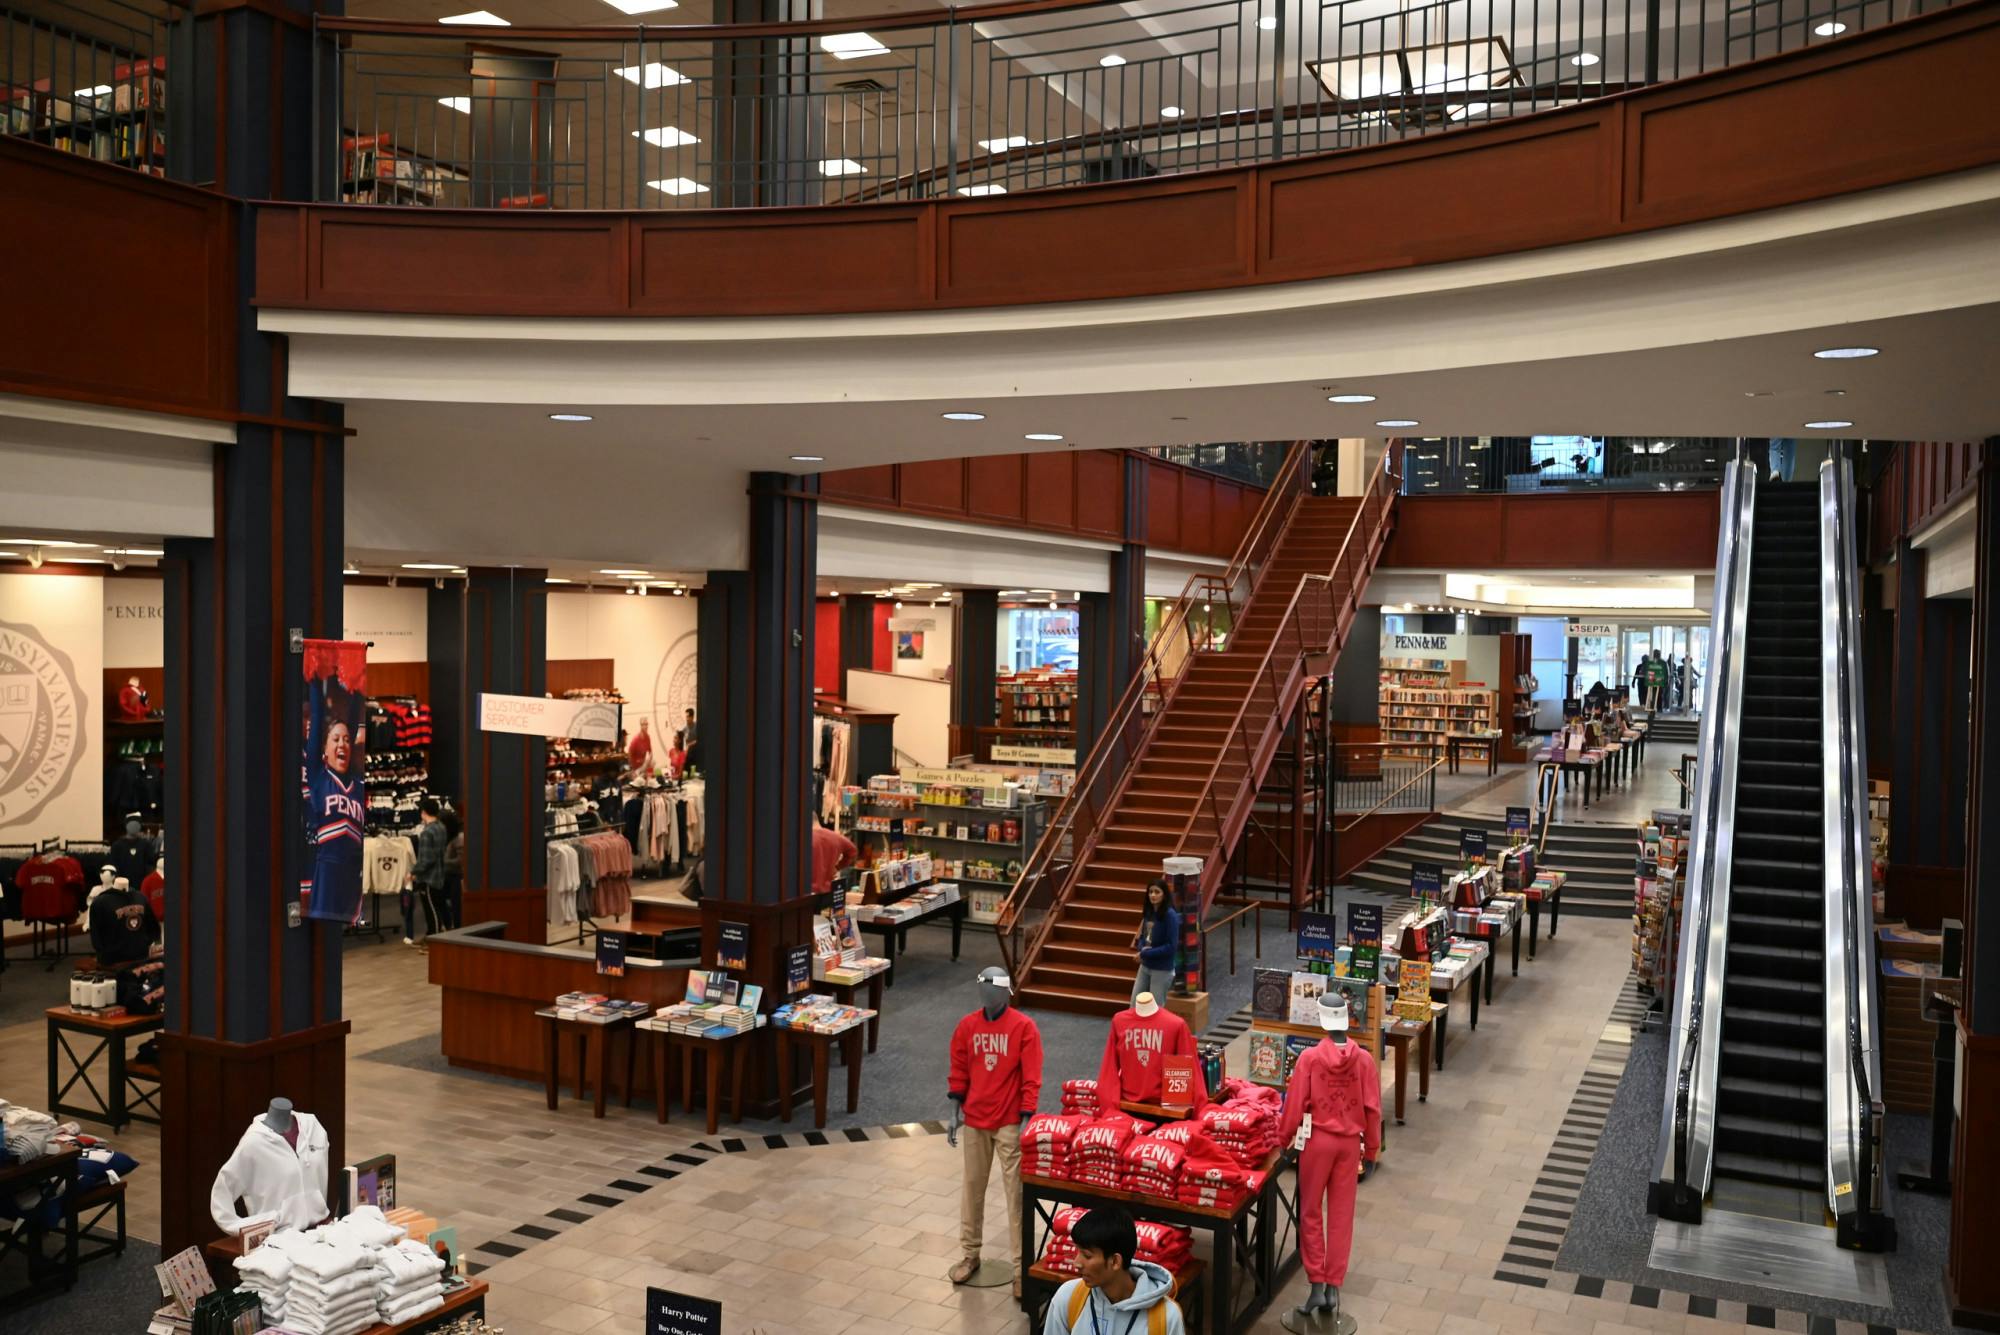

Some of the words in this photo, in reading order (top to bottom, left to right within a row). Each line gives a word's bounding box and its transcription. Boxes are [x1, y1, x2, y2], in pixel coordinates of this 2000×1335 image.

[1581, 625, 1611, 633] SEPTA
[1395, 635, 1447, 650] PENN&ME
[486, 700, 545, 714] CUSTOMER
[486, 714, 528, 728] SERVICE
[1018, 750, 1040, 759] Games
[916, 771, 943, 782] Games
[945, 773, 952, 782] &
[953, 773, 985, 784] Puzzles
[377, 856, 399, 865] PENN
[1301, 931, 1330, 940] Calendars
[1305, 925, 1326, 933] Advent
[972, 1033, 1008, 1057] PENN
[1125, 1028, 1163, 1054] PENN
[1168, 1079, 1188, 1093] 25%
[1203, 1111, 1248, 1122] PENN
[1025, 1118, 1068, 1137] PENN
[1072, 1127, 1115, 1149] PENN
[1131, 1143, 1175, 1170] PENN
[661, 1305, 683, 1319] Harry
[685, 1311, 708, 1323] Potter
[658, 1323, 670, 1333] Buy
